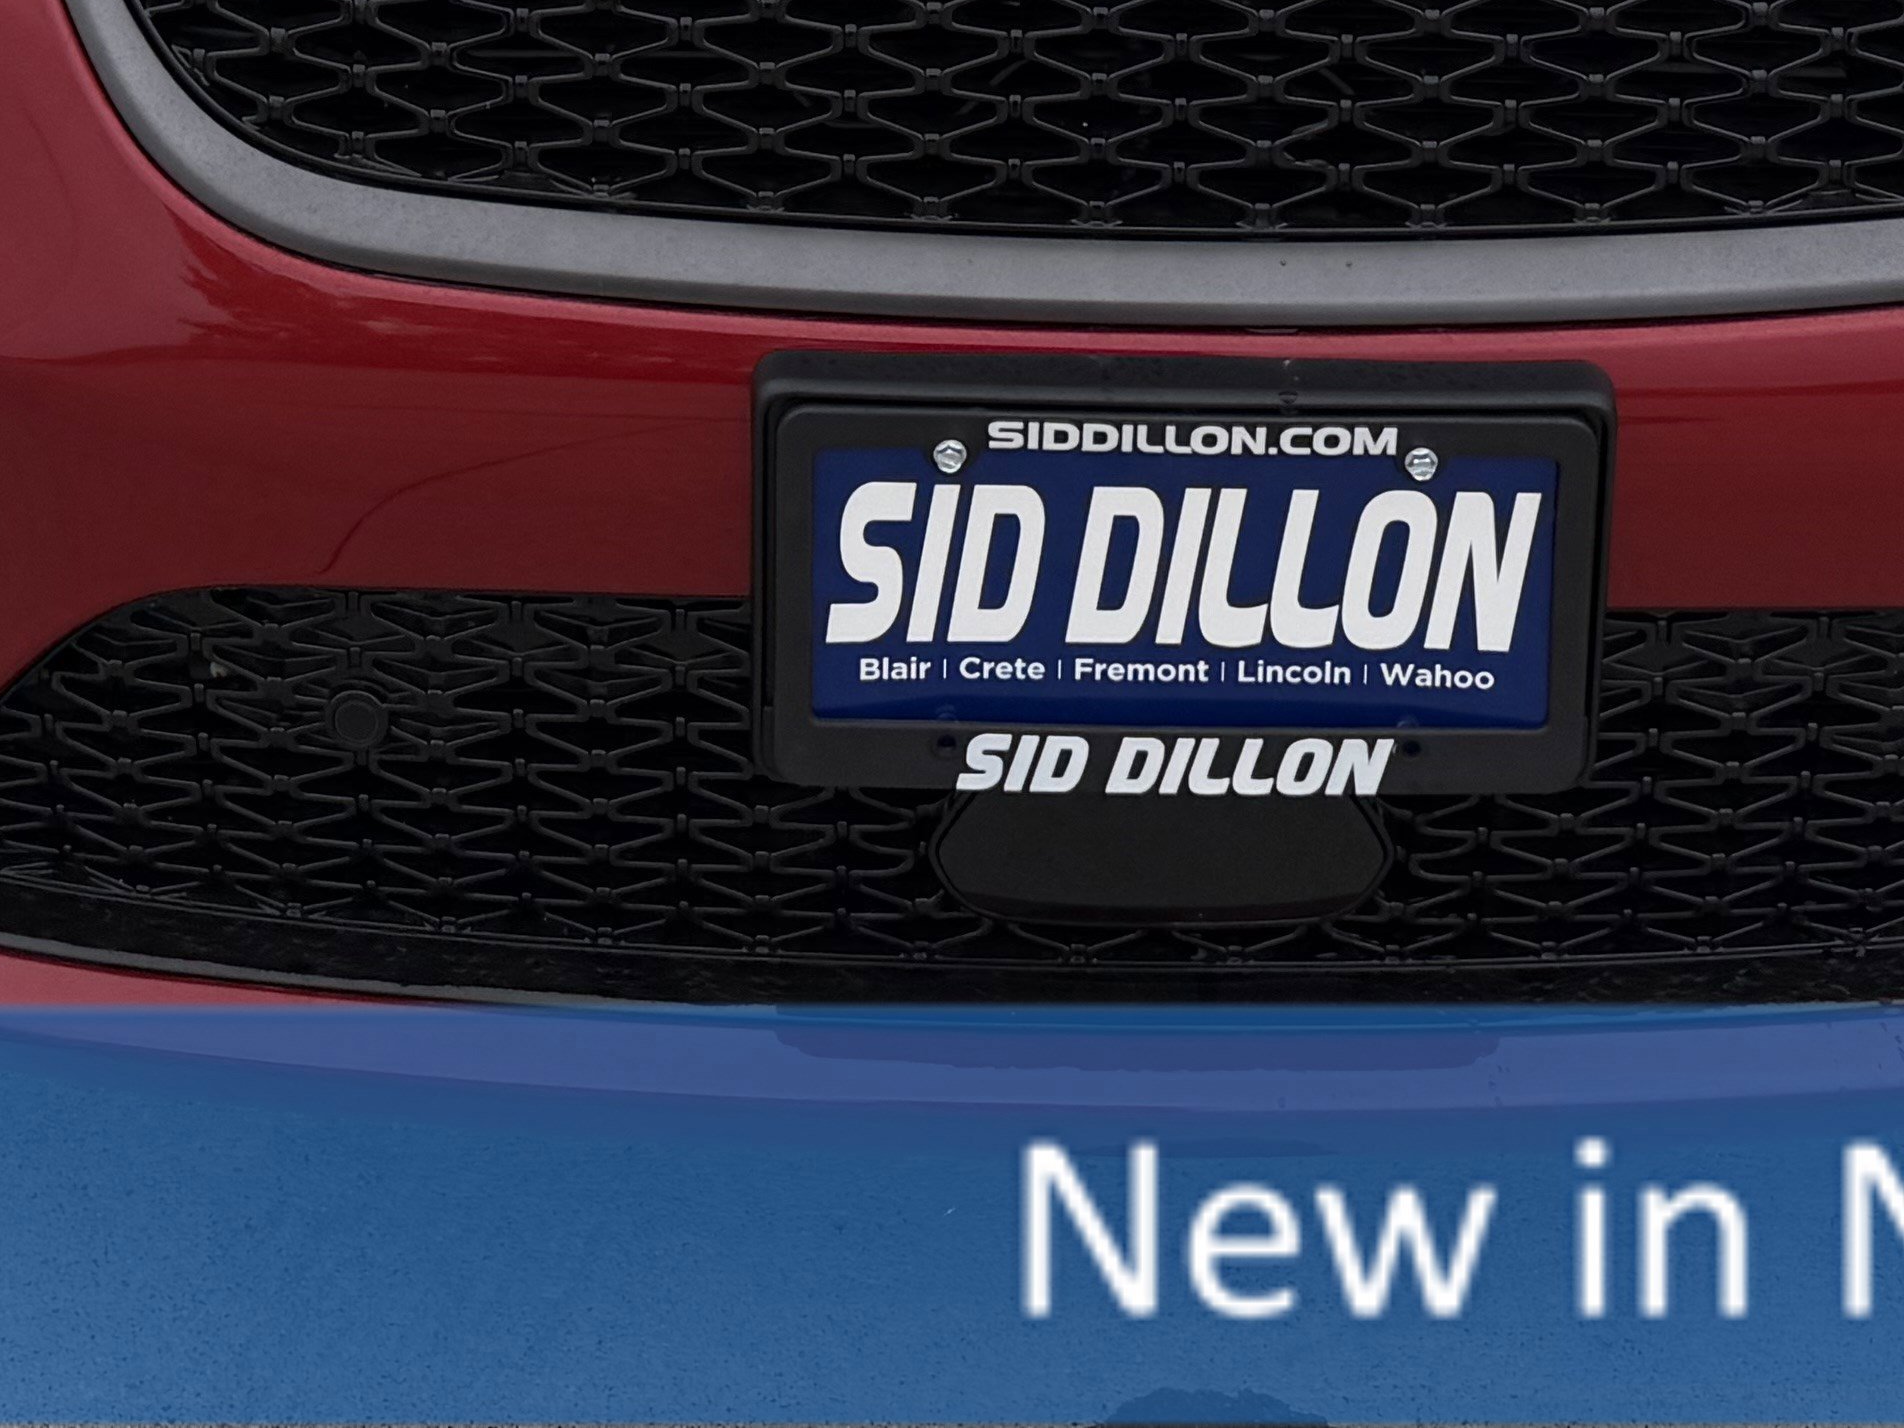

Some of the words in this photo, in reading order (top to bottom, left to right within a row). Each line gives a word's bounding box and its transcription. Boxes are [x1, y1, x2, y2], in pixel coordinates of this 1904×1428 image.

[987, 420, 1398, 456] SIDDILLON.COM
[825, 481, 1046, 644] SID
[1065, 487, 1542, 652] DILLON
[859, 656, 932, 681] Blair
[959, 656, 1046, 681] Crete
[1074, 657, 1210, 683] Fremont
[1237, 659, 1351, 685] Lincoln
[1380, 662, 1495, 690] Wahoo
[955, 733, 1090, 793] SID
[1104, 736, 1395, 796] DILLON
